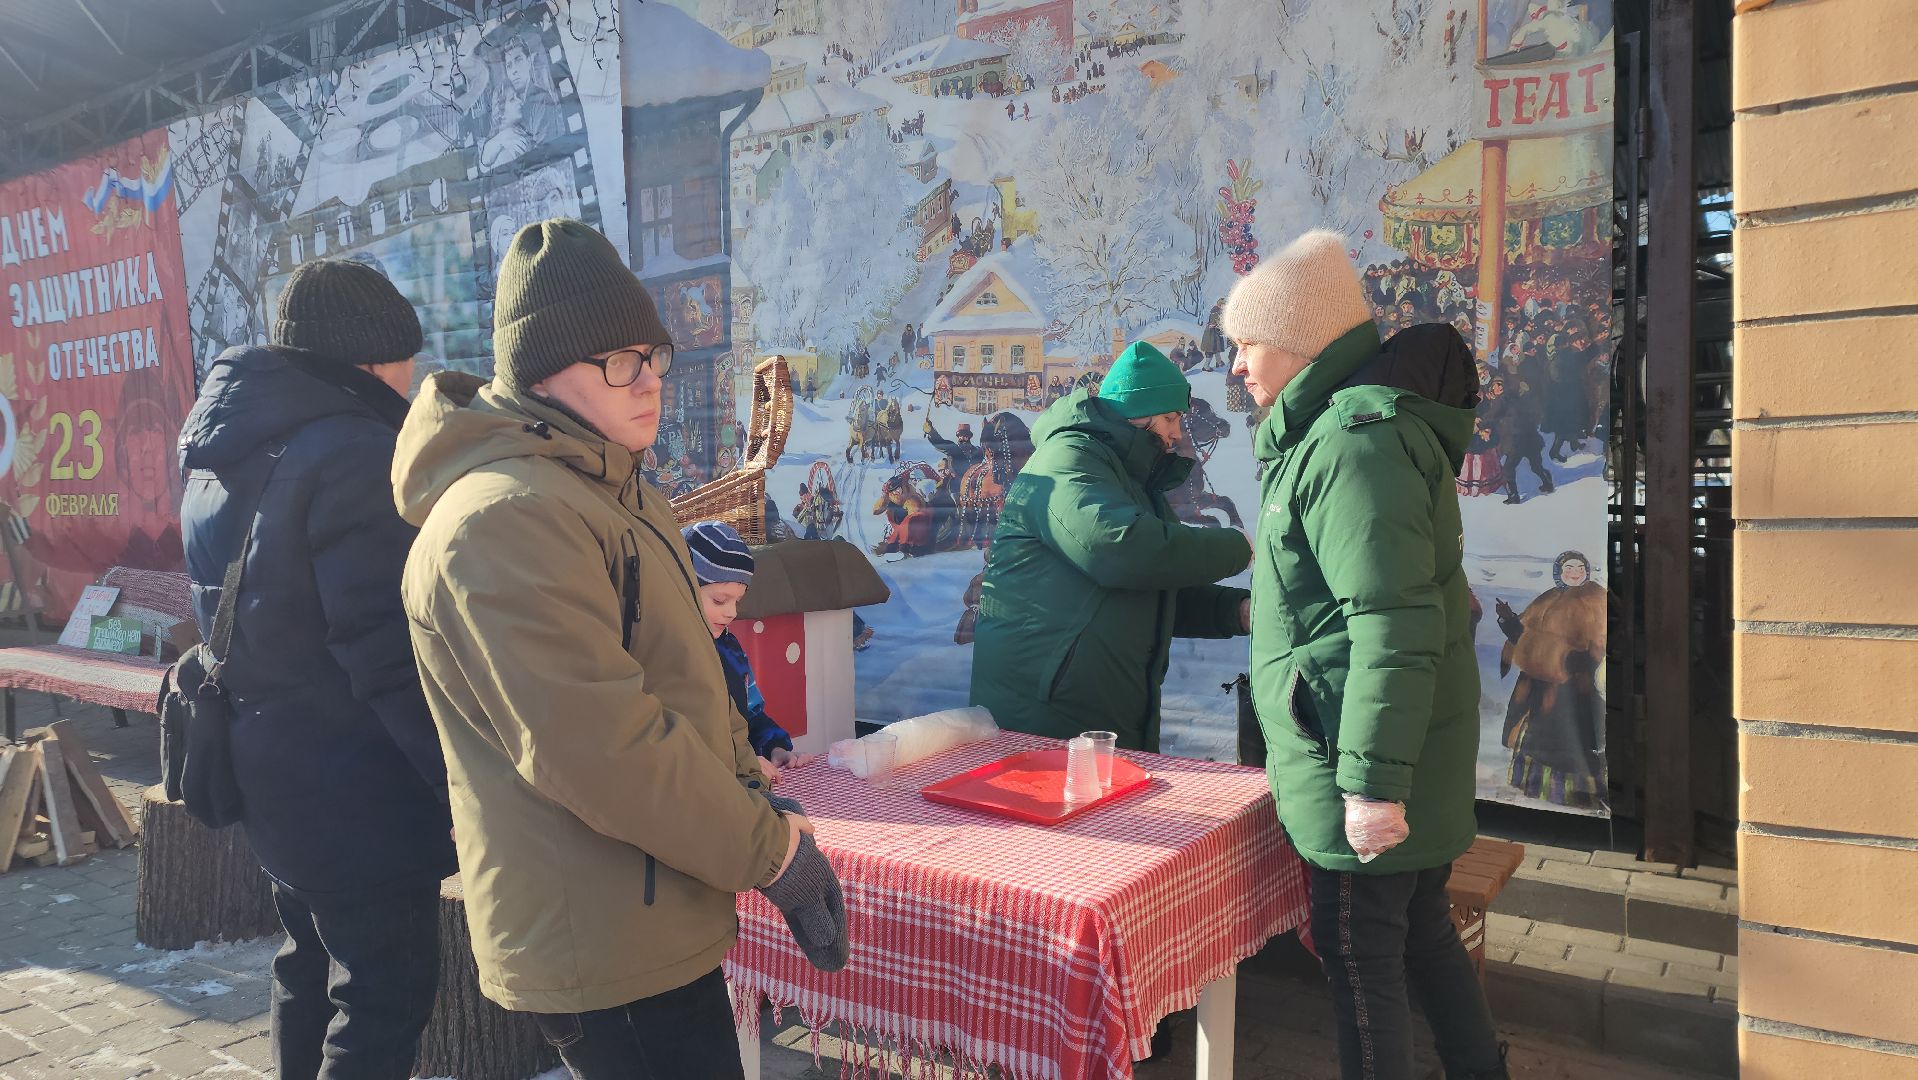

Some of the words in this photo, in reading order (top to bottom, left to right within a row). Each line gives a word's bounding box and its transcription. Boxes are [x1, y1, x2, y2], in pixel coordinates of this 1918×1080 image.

[1, 203, 70, 269] ДНЕМ
[8, 251, 163, 328] ЗАЩИТНИКА
[48, 327, 160, 381] ОТЕЧЕСТВА
[49, 409, 104, 481] 23
[45, 492, 119, 518] ФЕВРАЛЯ
